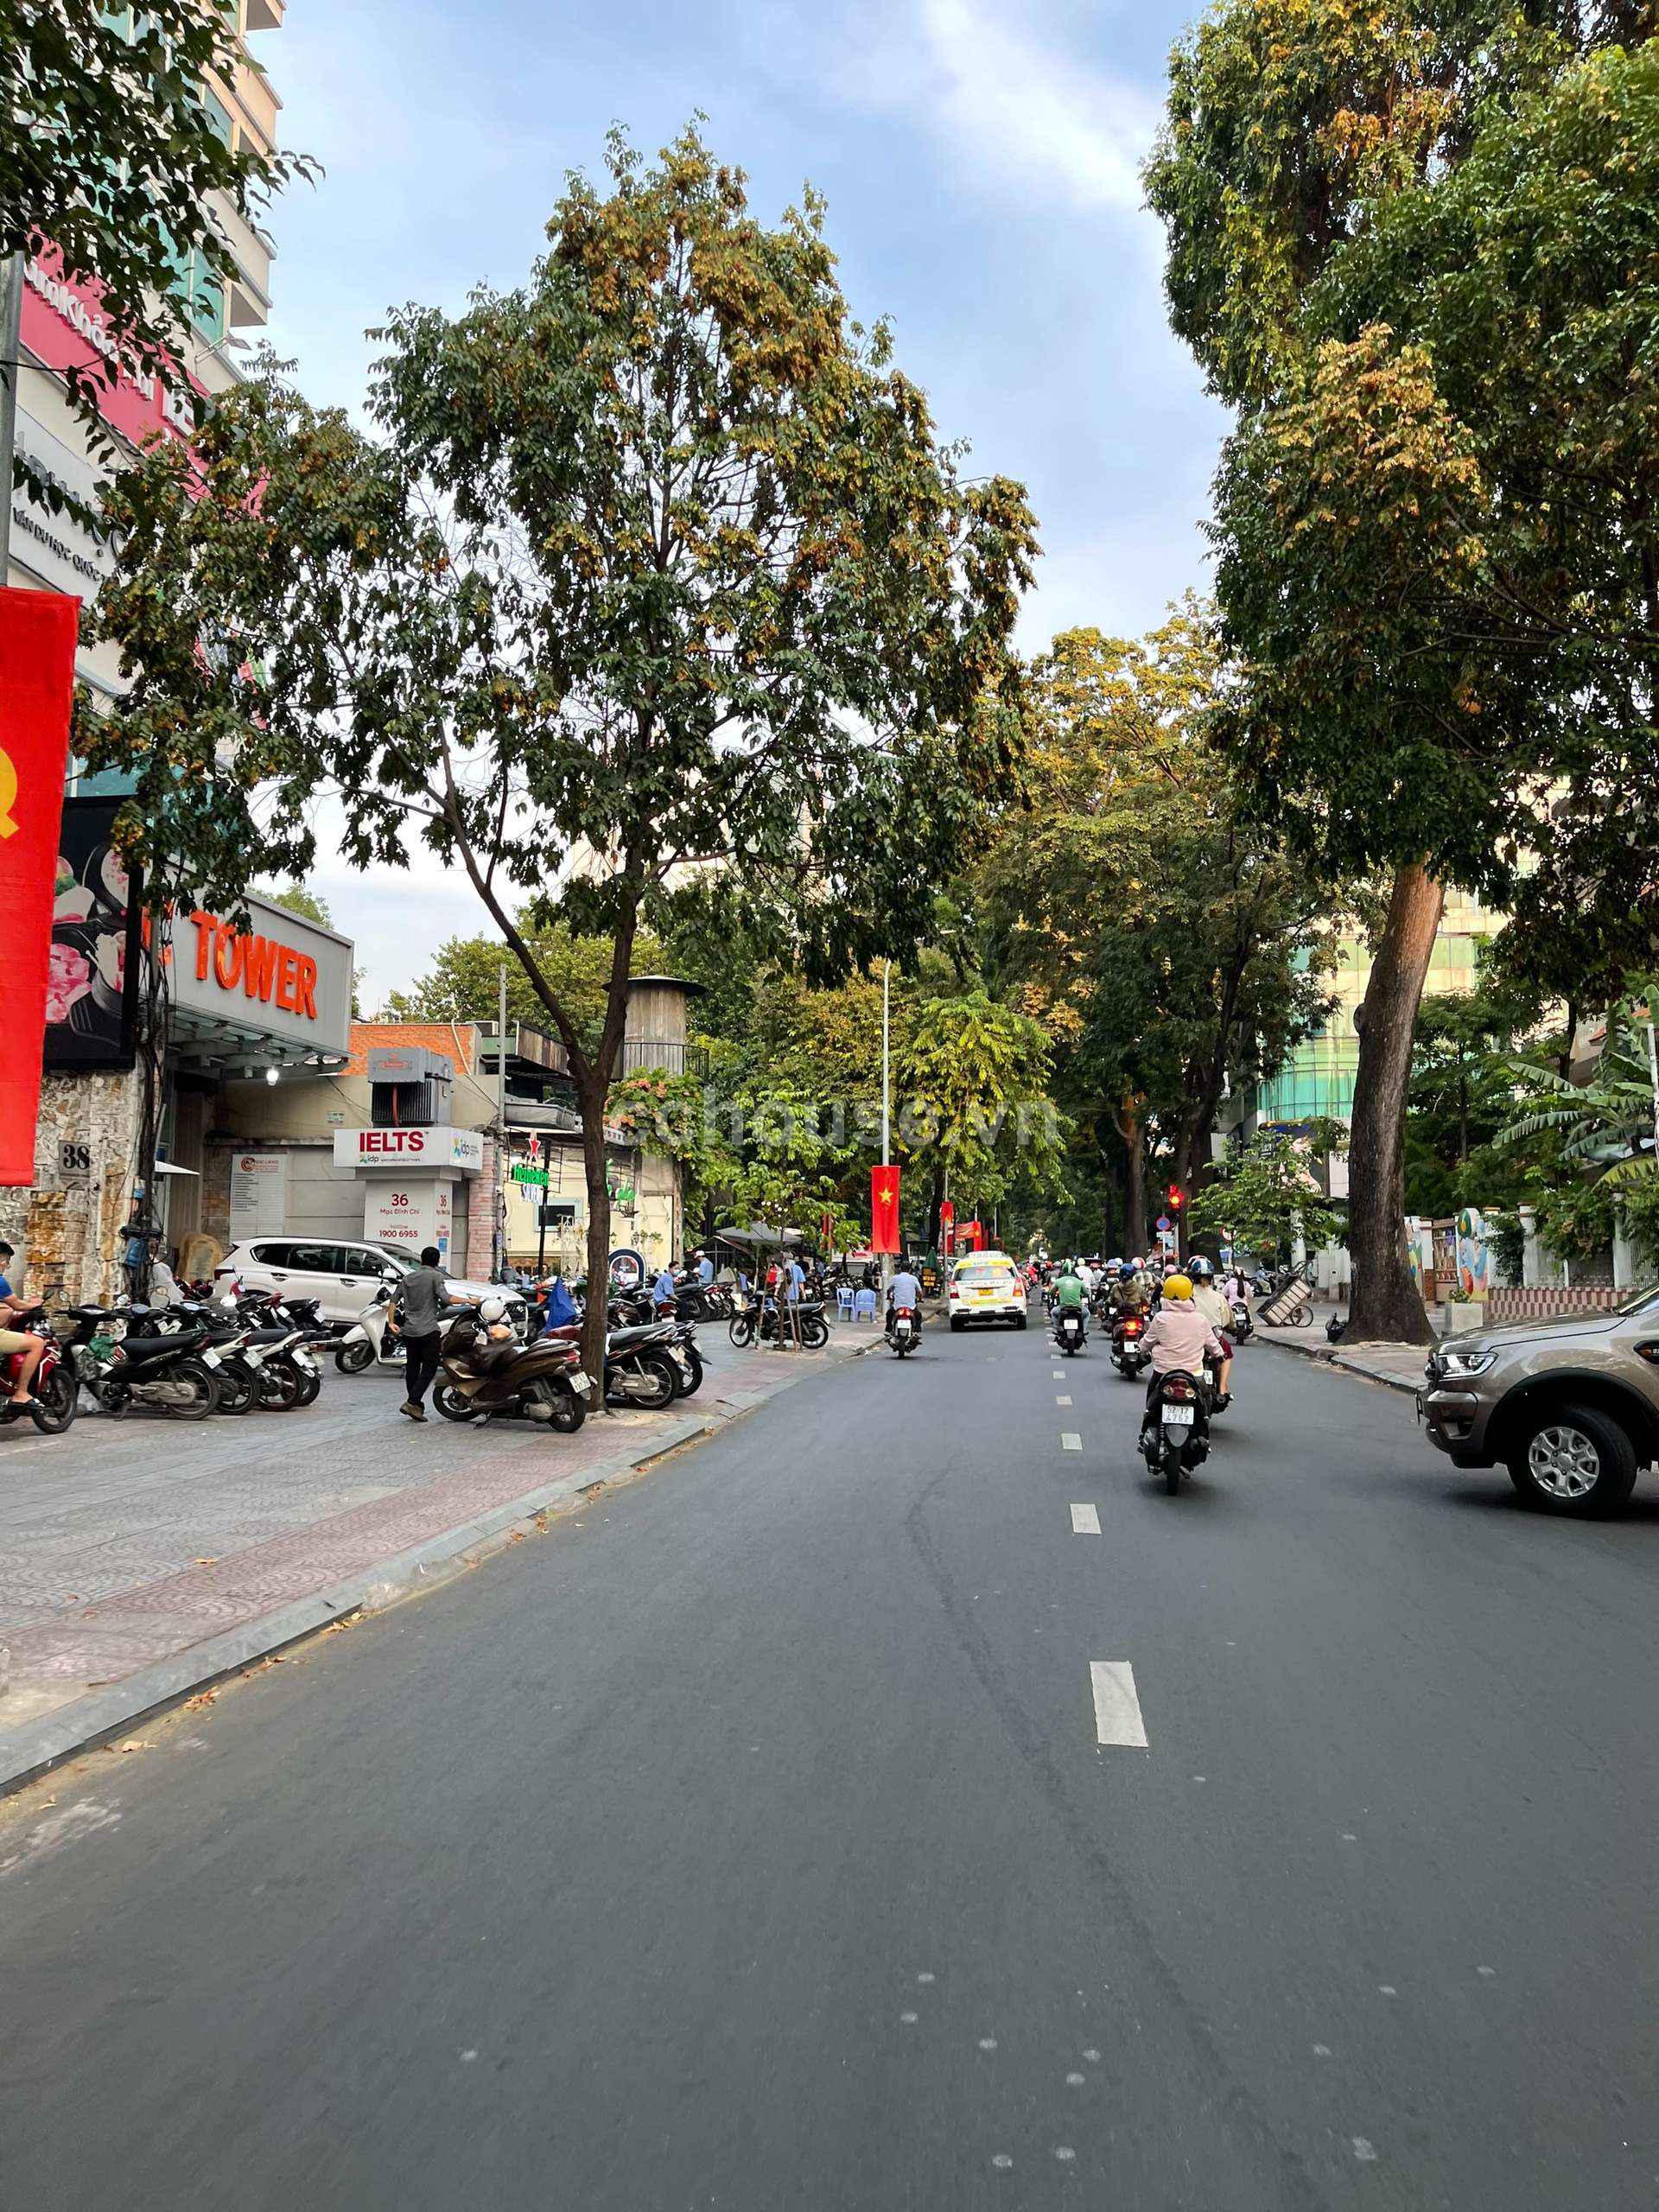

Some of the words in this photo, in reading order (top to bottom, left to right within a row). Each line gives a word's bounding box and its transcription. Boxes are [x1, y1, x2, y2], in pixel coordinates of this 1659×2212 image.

[190, 909, 317, 1020] TOWER
[359, 1131, 424, 1152] IELTS
[63, 1144, 90, 1169] 38
[513, 1164, 549, 1186] Heineken
[391, 1193, 408, 1206] 36
